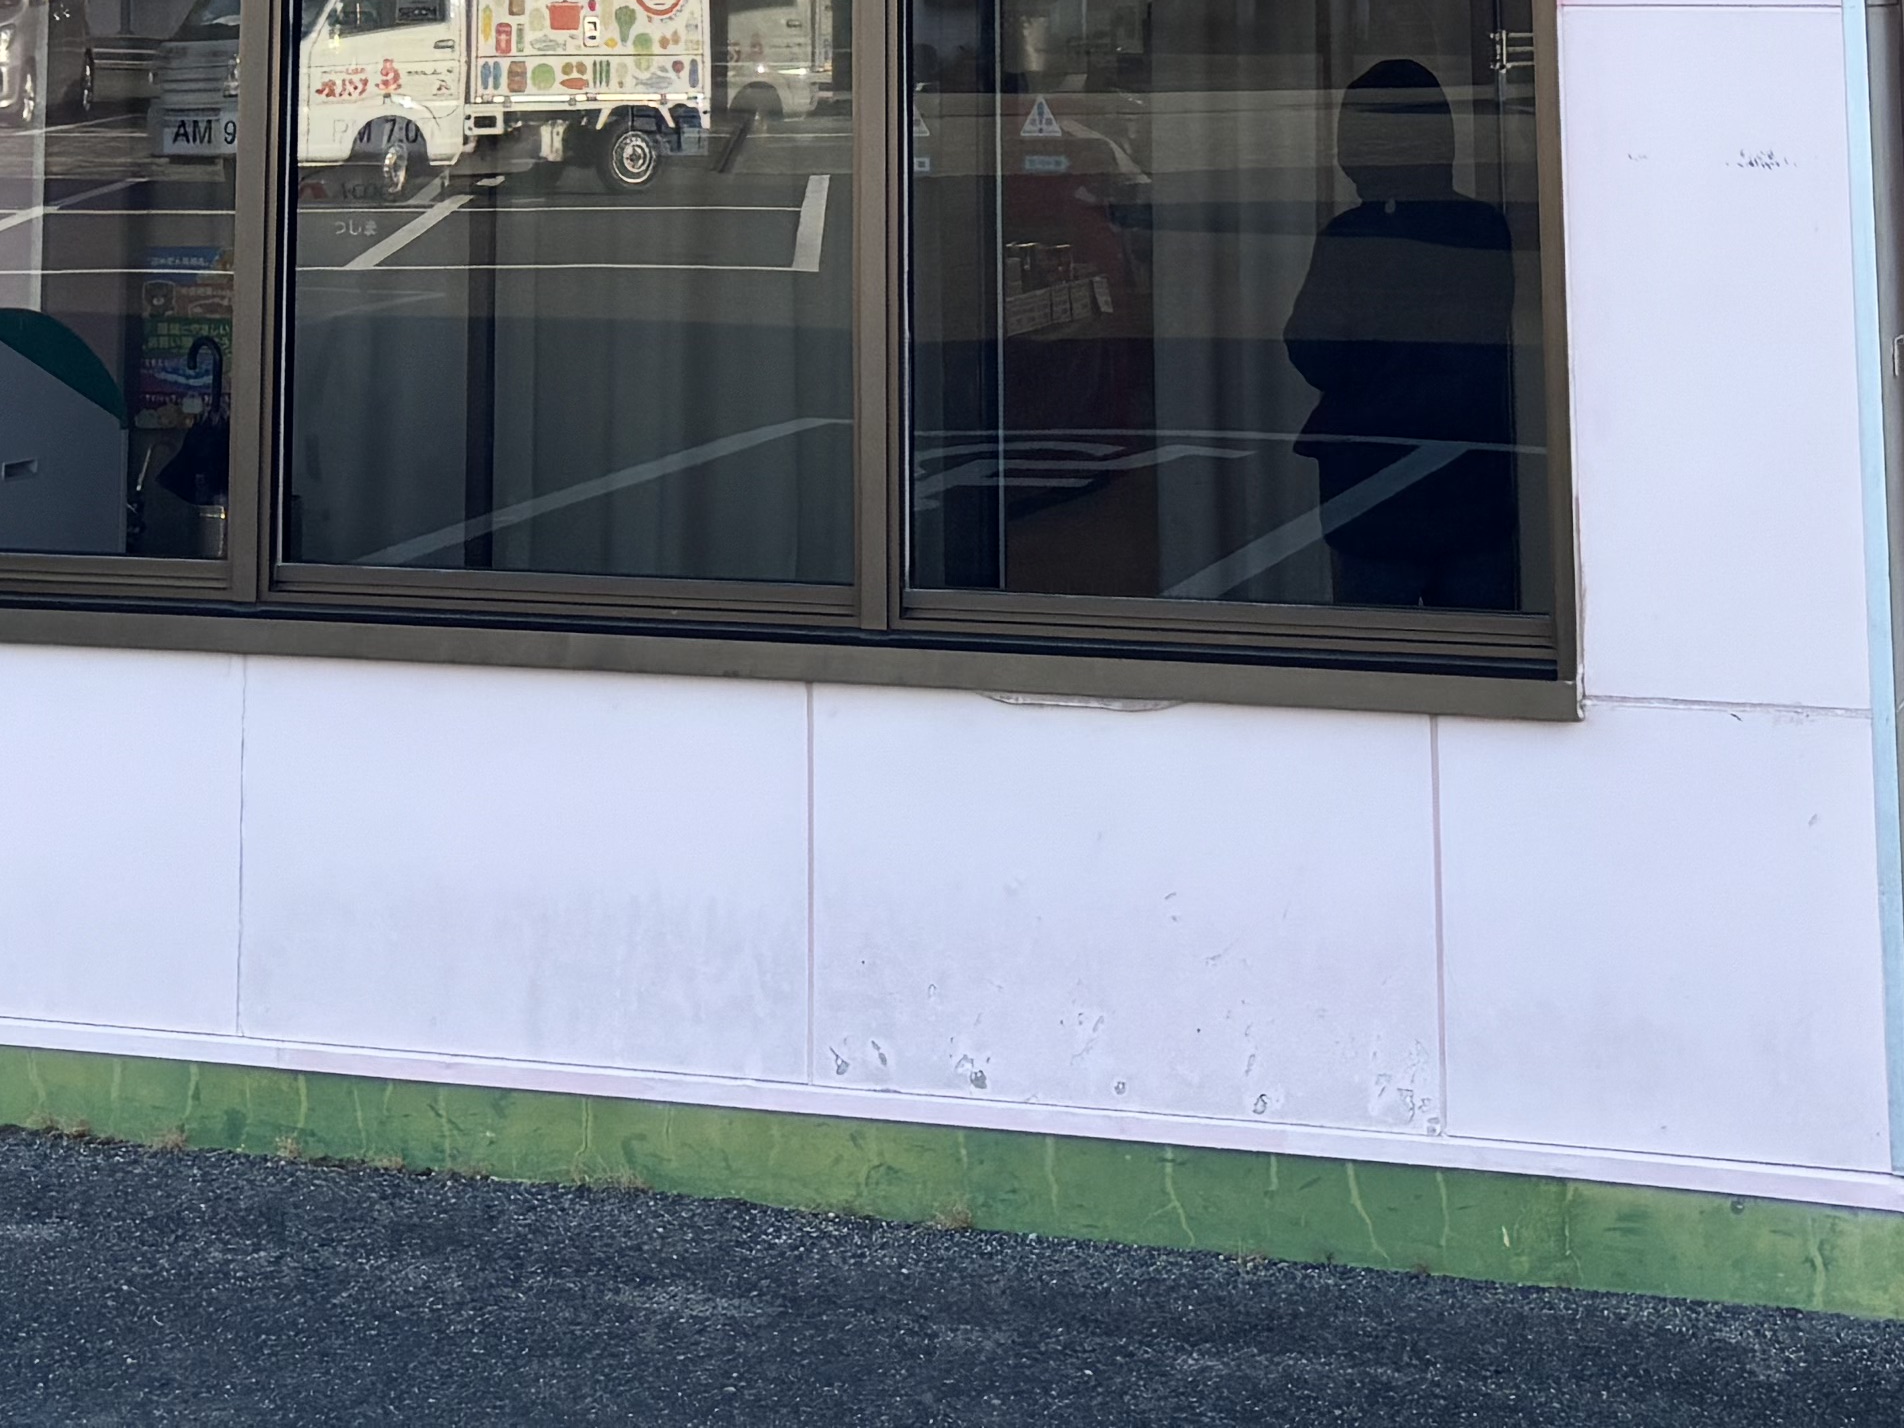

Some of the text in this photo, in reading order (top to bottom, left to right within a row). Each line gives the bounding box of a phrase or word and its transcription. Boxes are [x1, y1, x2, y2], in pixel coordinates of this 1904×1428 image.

[172, 119, 213, 145] AM
[384, 118, 423, 144] 7:0
[333, 219, 378, 237] つしま
